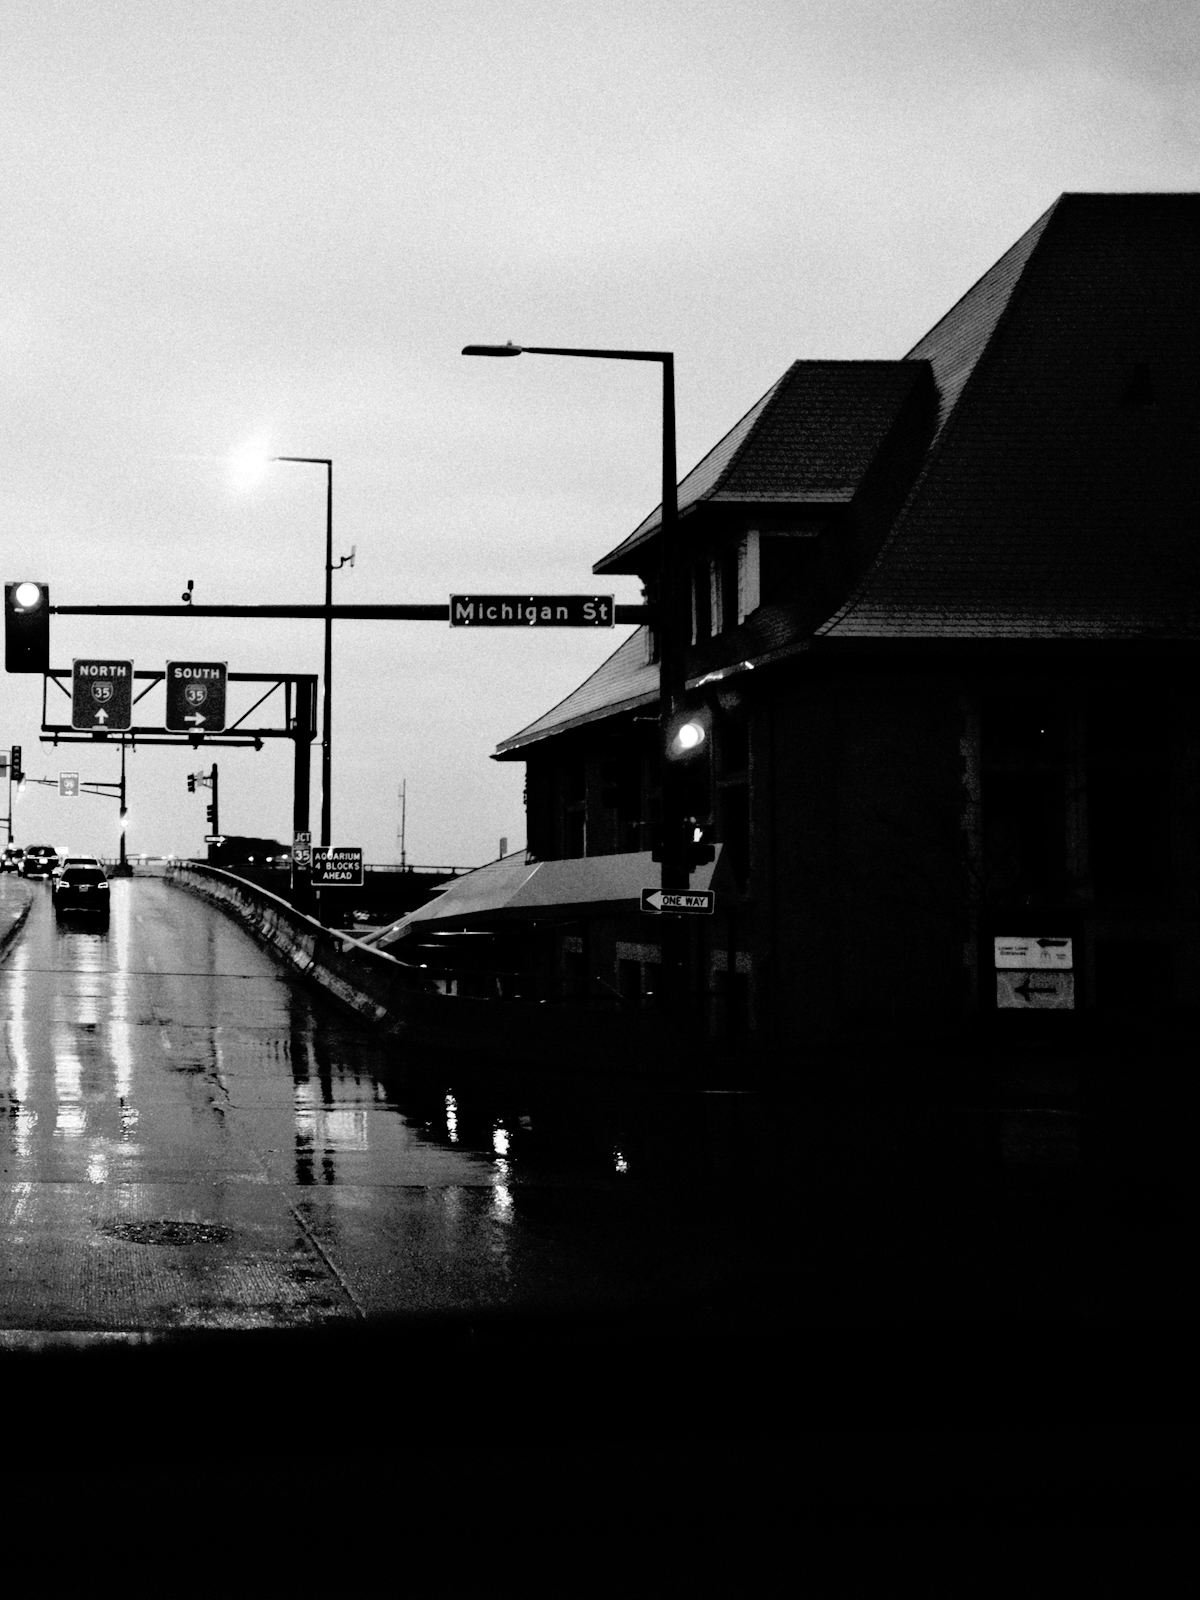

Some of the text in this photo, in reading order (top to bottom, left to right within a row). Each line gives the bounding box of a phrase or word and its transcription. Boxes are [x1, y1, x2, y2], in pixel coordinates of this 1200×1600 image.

[455, 602, 608, 625] Michigan St
[79, 665, 126, 677] NORTH
[174, 667, 220, 679] SOUTH
[94, 687, 110, 698] 35
[188, 690, 204, 701] 35
[295, 832, 311, 842] JCT
[295, 850, 310, 861] 35
[314, 862, 321, 870] 4
[325, 861, 360, 870] BLOCKS
[322, 871, 353, 880] AHEAD
[662, 896, 706, 907] ONE WAY
